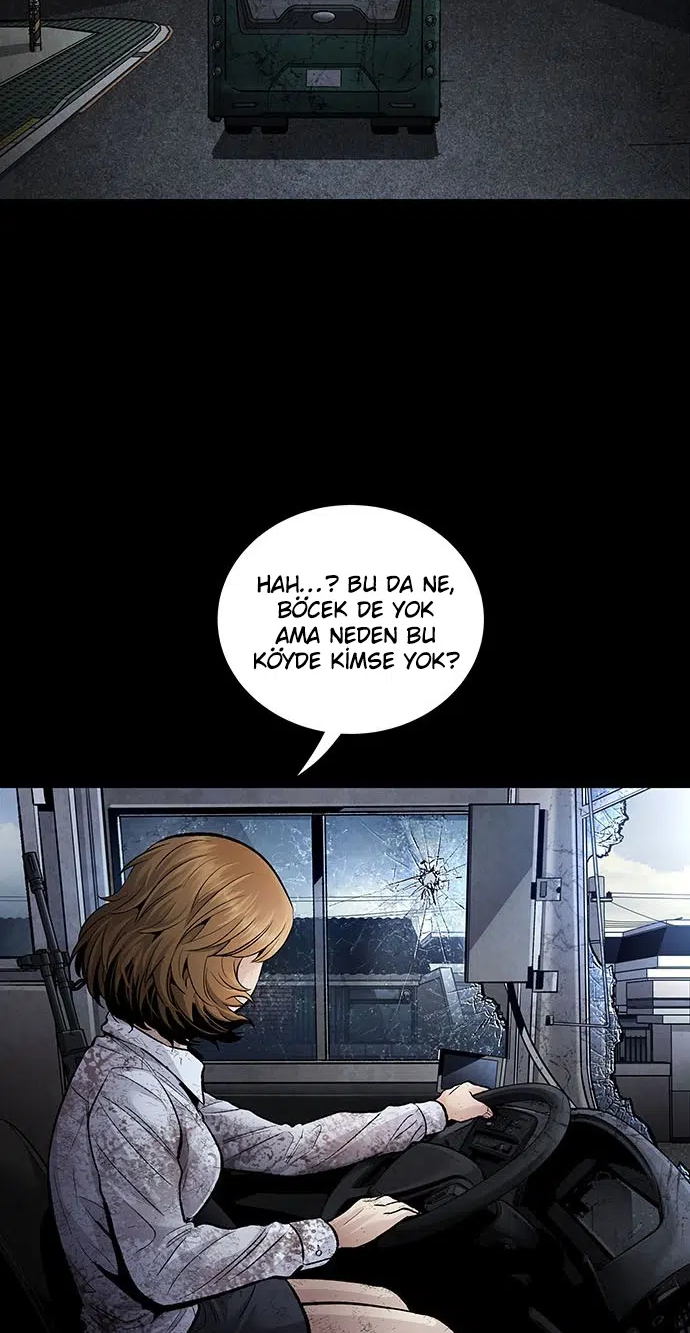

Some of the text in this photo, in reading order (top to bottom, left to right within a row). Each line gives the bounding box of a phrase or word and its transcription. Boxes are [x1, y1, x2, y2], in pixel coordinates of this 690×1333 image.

[257, 574, 455, 595] HAH...? BU DA NE,
[277, 596, 435, 618] BÖCEK DE YOK
[275, 626, 436, 644] AMA NEDEN BU
[253, 647, 460, 670] KÖYDE KİMSE YOK?
